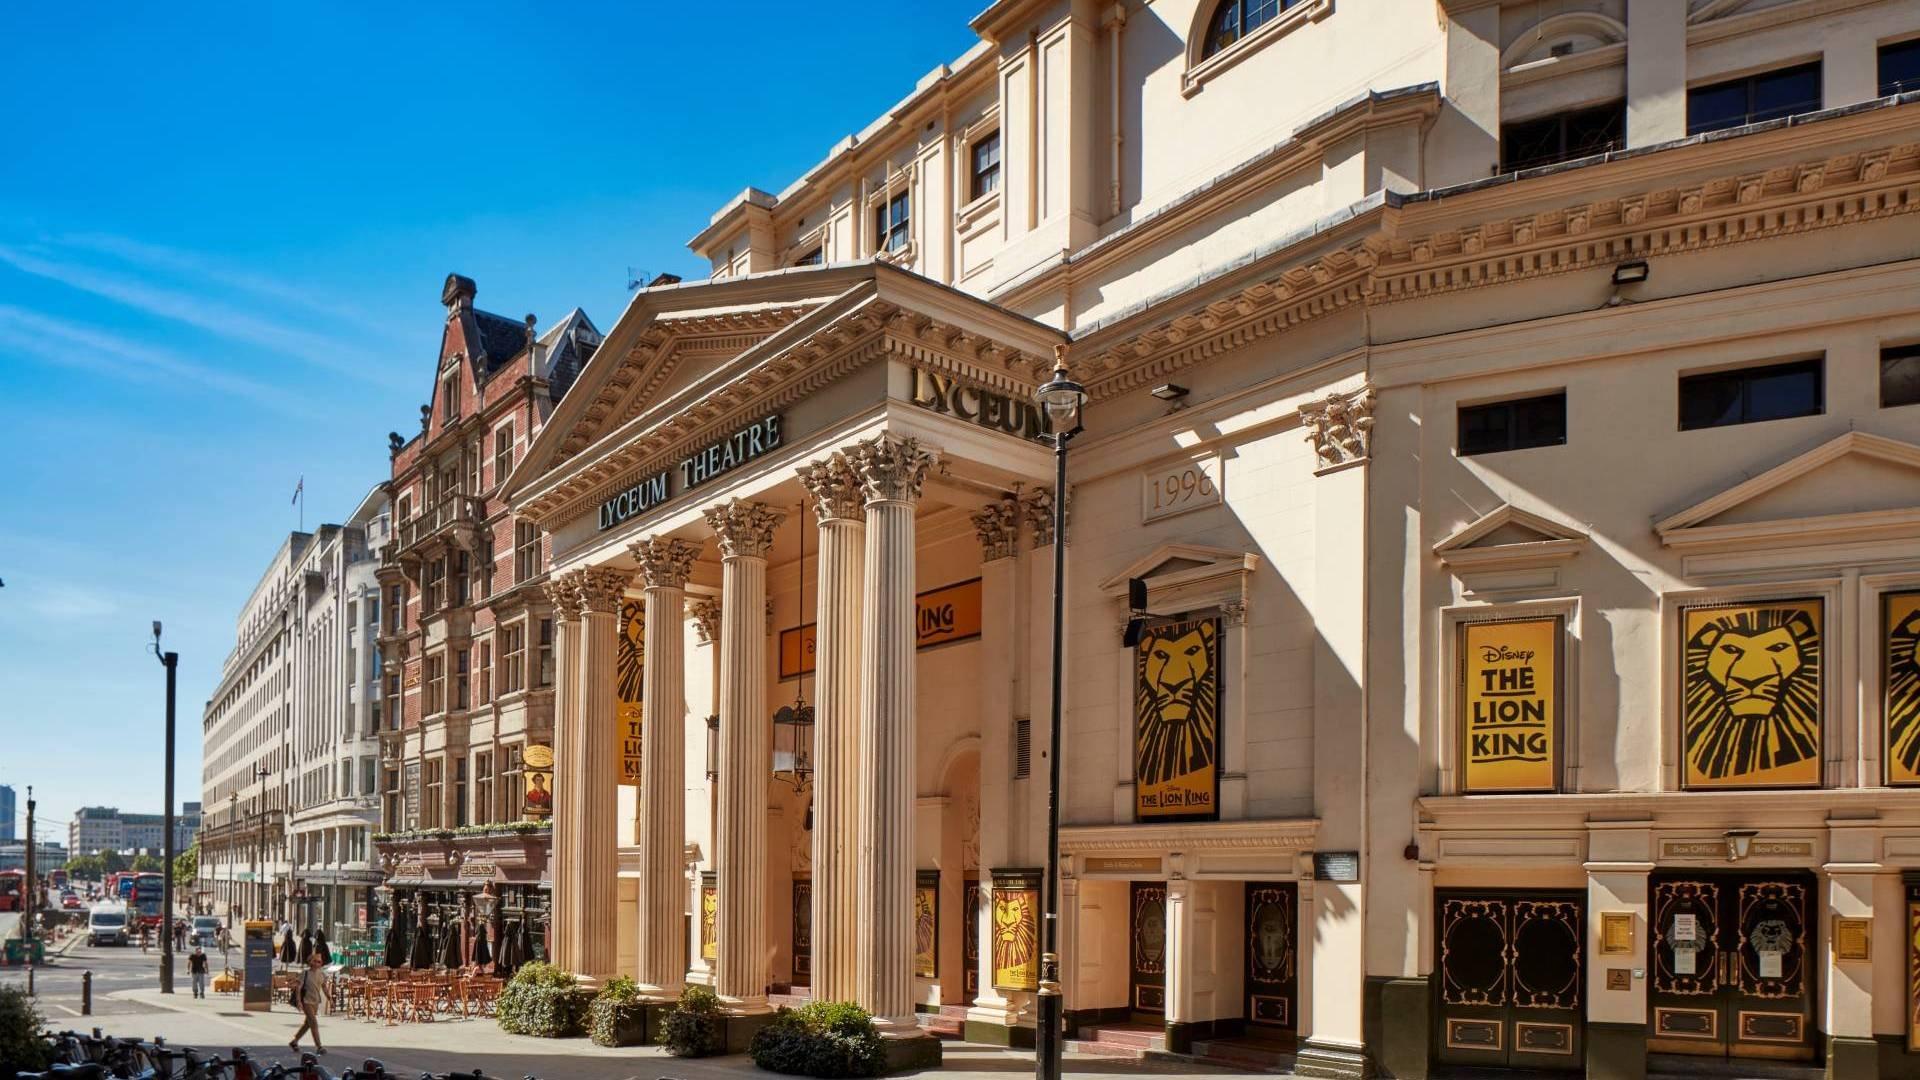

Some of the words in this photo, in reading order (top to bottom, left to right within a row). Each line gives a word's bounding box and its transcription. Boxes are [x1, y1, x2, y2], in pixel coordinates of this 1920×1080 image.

[912, 368, 1053, 438] LYCEUM
[598, 472, 669, 531] LYCEUM
[680, 415, 781, 489] THEATRE
[1153, 463, 1213, 512] 1996
[1481, 667, 1535, 691] THE
[1474, 700, 1545, 724] LION
[1472, 732, 1548, 757] KING
[624, 760, 641, 774] KI
[1141, 794, 1157, 805] THE
[1160, 791, 1183, 807] LION
[1185, 789, 1210, 806] KING
[1673, 844, 1688, 854] Box
[1690, 844, 1717, 854] Office
[1755, 844, 1770, 854] Box
[1773, 844, 1800, 854] Office
